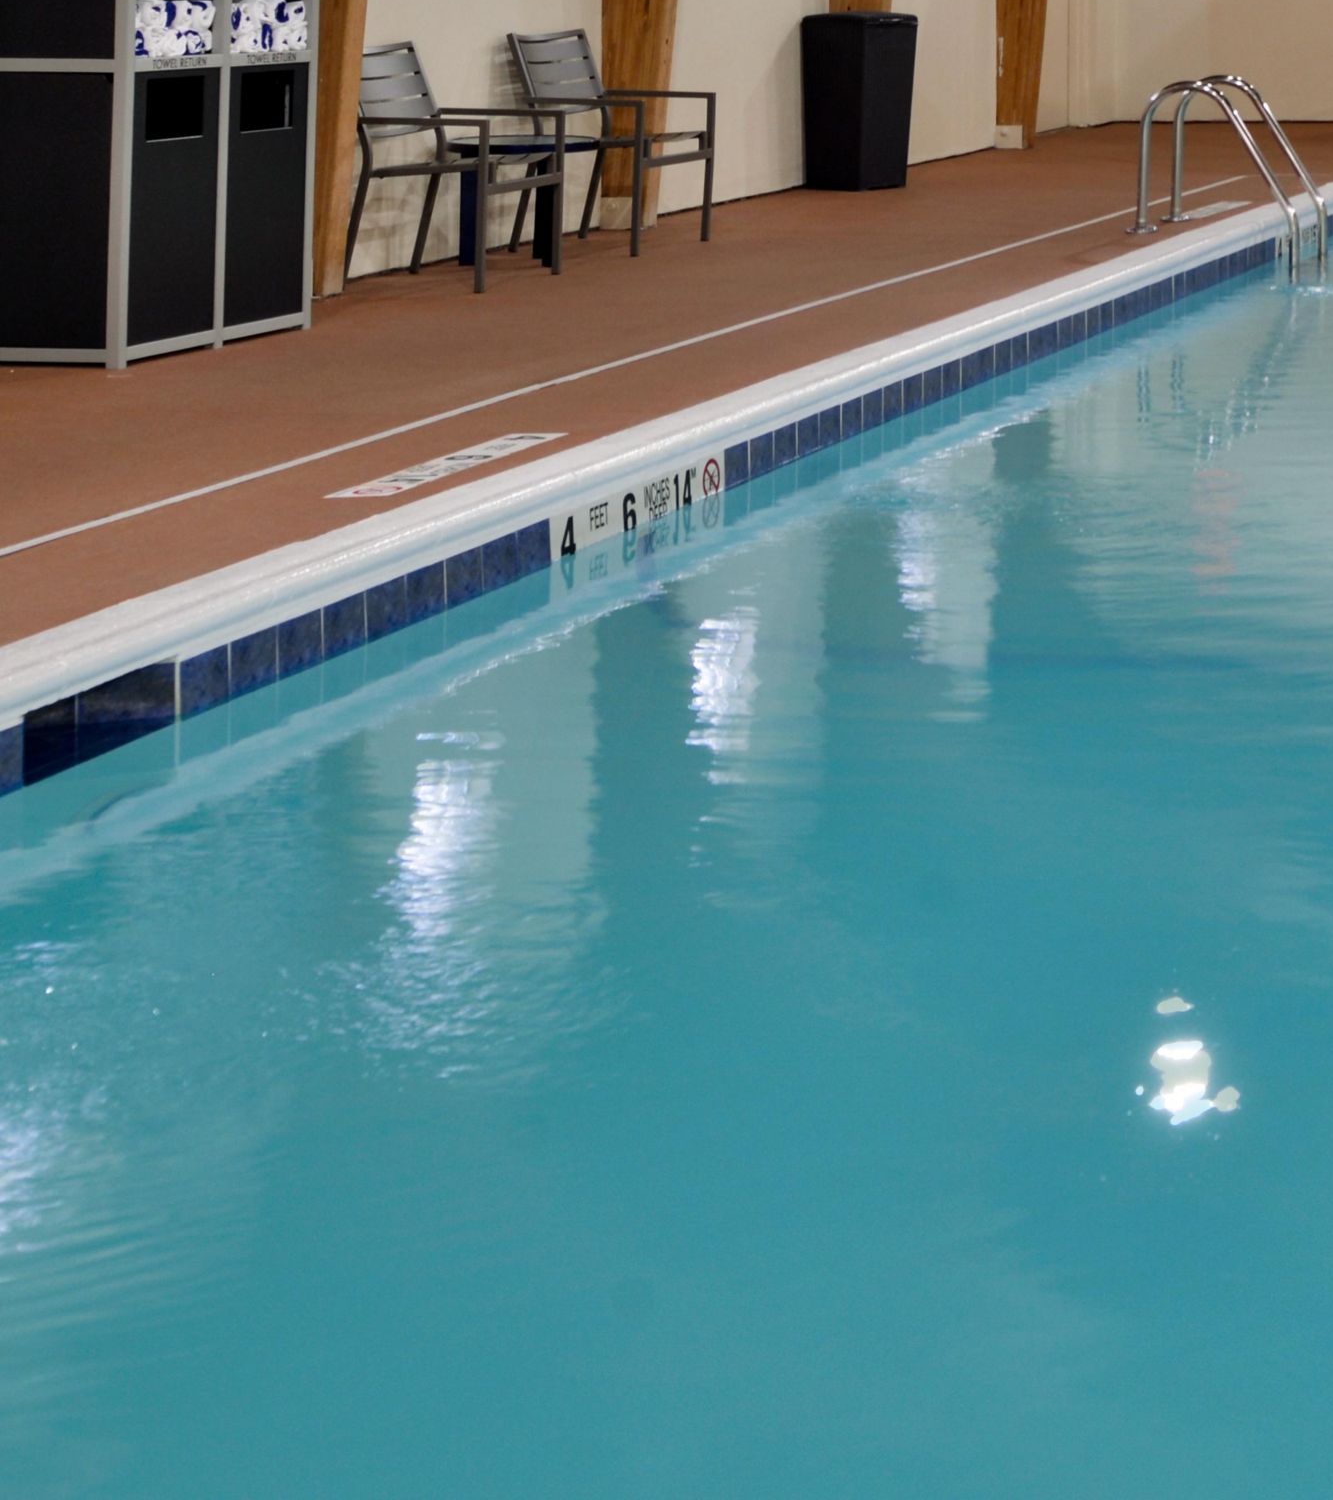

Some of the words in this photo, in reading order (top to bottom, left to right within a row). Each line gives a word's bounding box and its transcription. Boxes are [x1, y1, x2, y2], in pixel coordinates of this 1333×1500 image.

[152, 58, 177, 69] TOWEL
[180, 56, 207, 67] RETURN
[561, 515, 577, 556] 4
[589, 501, 609, 532] FEET
[623, 492, 637, 531] 6
[643, 477, 670, 509] INCHES
